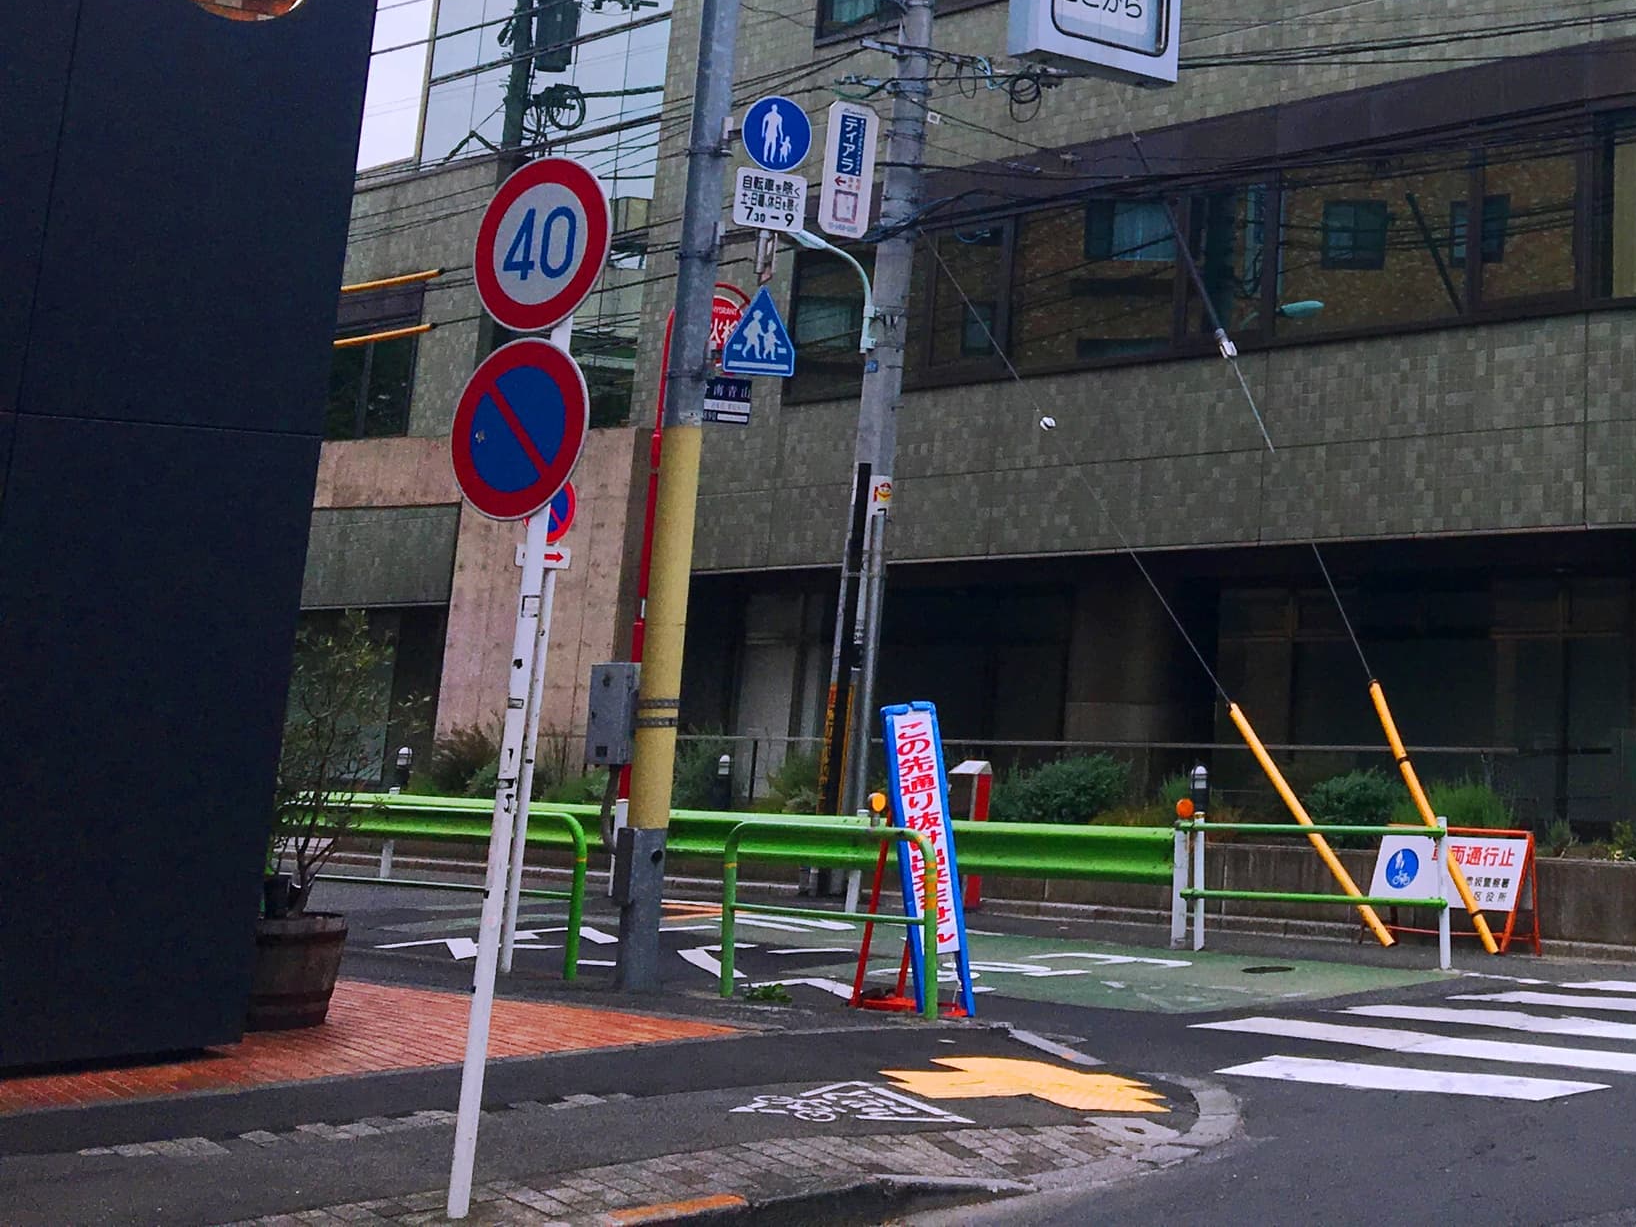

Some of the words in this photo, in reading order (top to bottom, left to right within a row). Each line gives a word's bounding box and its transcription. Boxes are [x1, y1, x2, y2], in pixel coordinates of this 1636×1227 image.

[841, 117, 858, 172] ティアラ
[742, 174, 801, 197] 自転車を除く
[501, 206, 578, 281] 40
